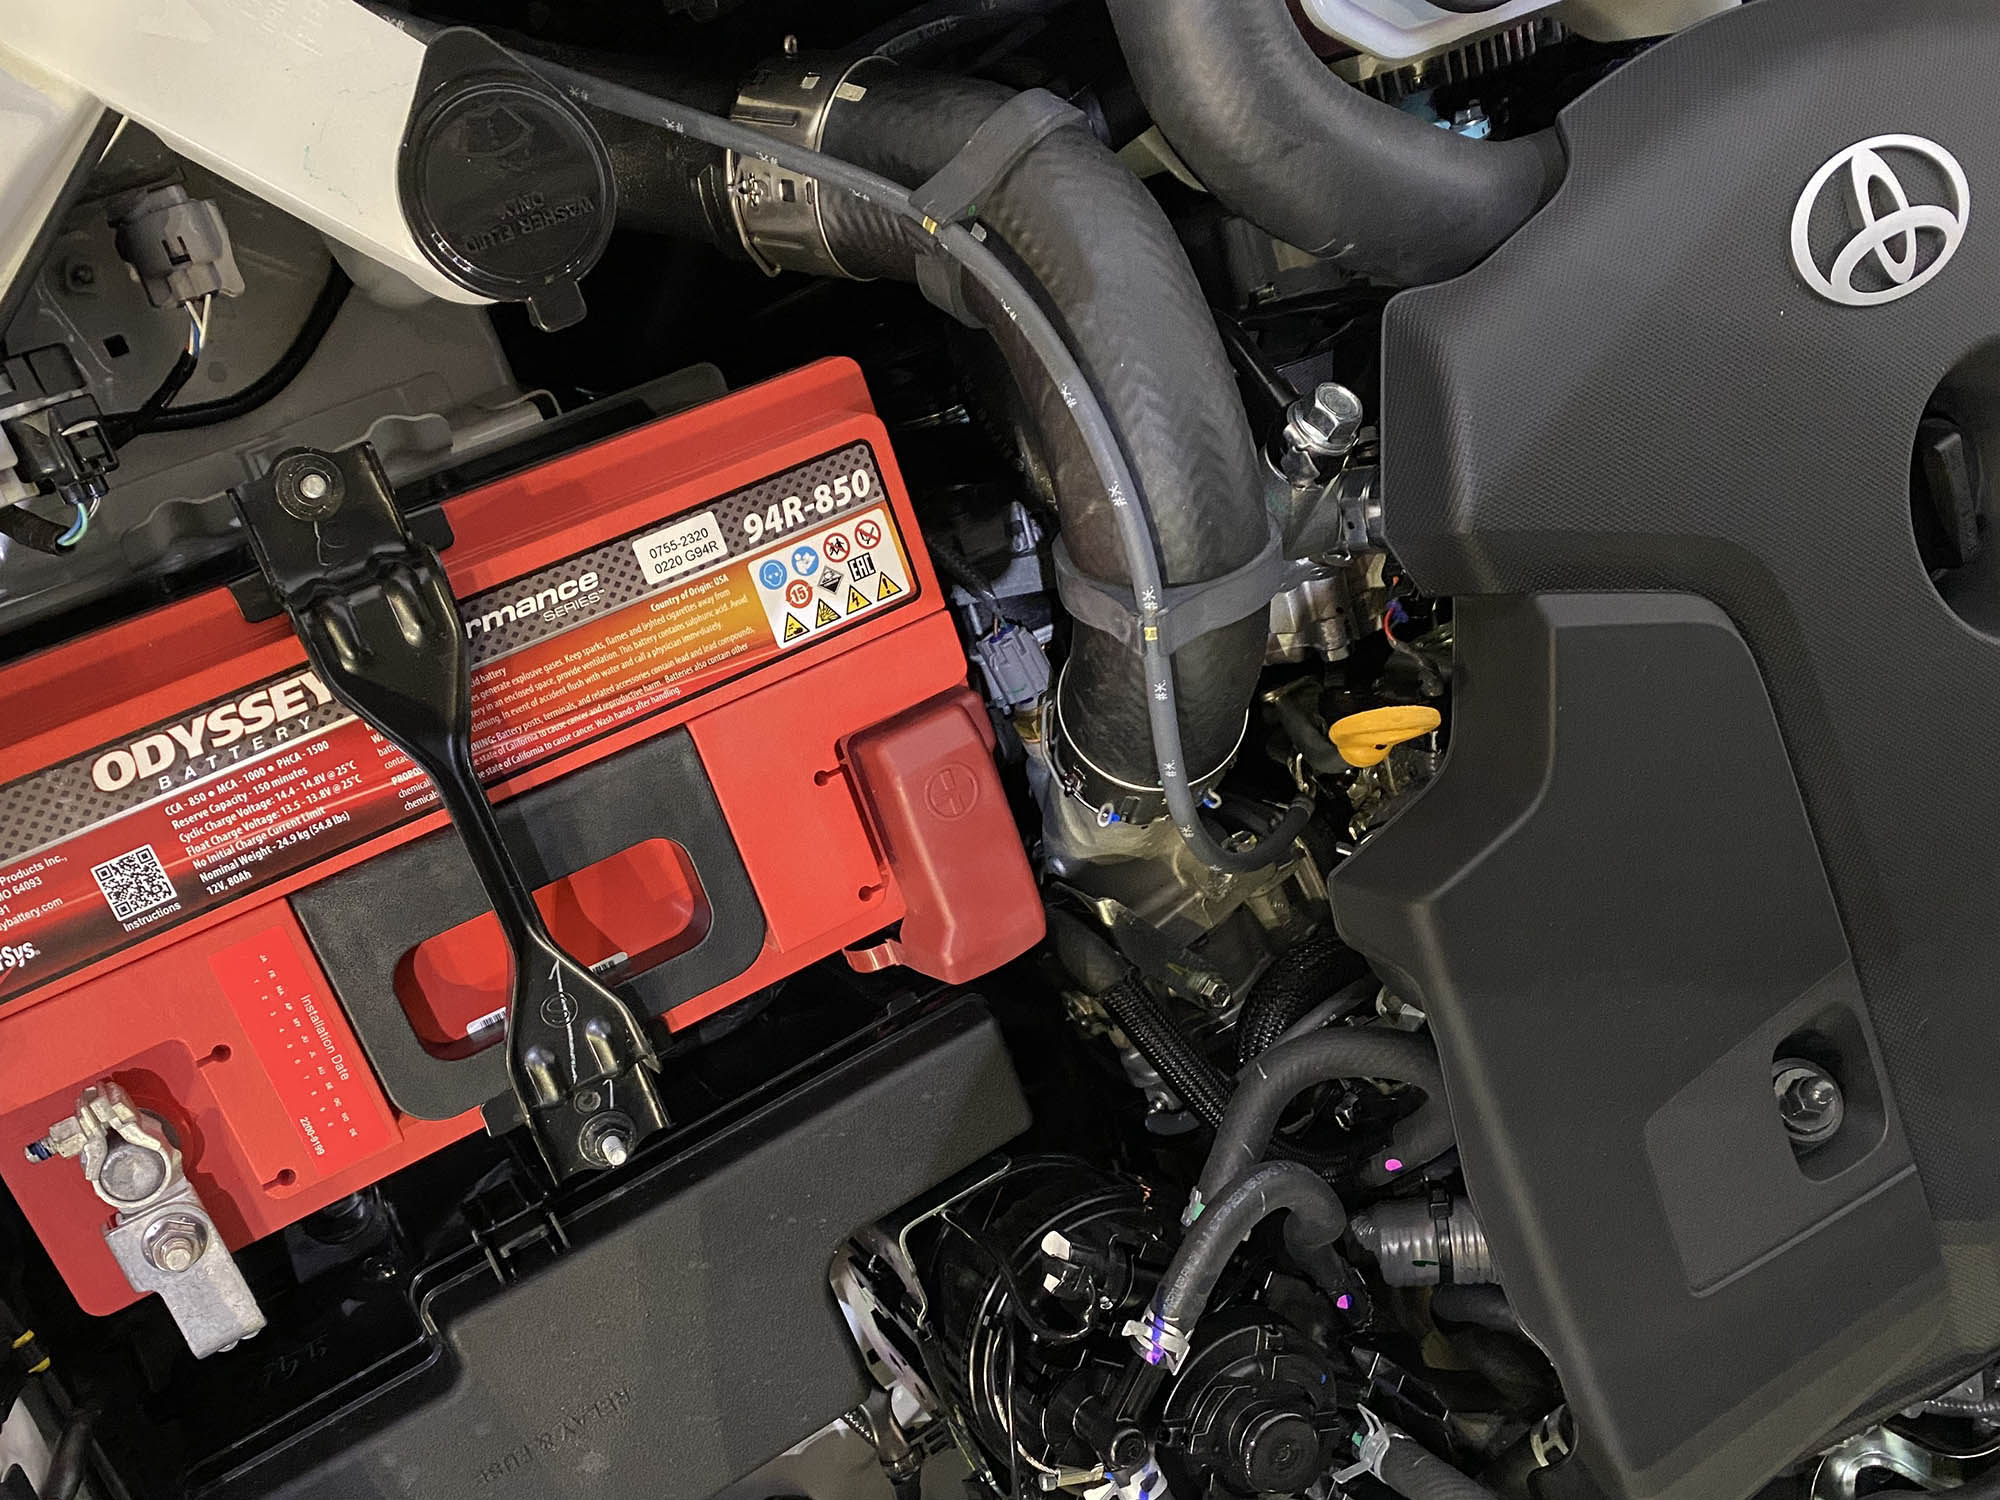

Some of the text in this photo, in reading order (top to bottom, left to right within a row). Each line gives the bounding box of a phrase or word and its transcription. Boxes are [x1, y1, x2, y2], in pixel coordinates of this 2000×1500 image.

[521, 197, 594, 236] WASHER
[743, 469, 872, 543] 94R-850
[648, 526, 709, 559] 0755-2320
[653, 539, 719, 575] 0220 G94R
[649, 573, 728, 614] Country of Origin: USA
[790, 585, 807, 601] 15
[479, 679, 512, 700] generate
[510, 665, 544, 687] explosive
[563, 649, 583, 664] Keep
[581, 640, 606, 657] sparks,
[604, 629, 628, 646] flames
[627, 624, 642, 636] and
[640, 613, 666, 632] lighted
[664, 601, 698, 622] cigarettes
[696, 595, 715, 609] away
[713, 587, 730, 600] from
[479, 665, 507, 685] battery
[485, 702, 494, 711] in
[493, 698, 504, 708] an
[502, 684, 534, 703] enclosed
[554, 664, 582, 683] provide
[618, 642, 633, 655] This
[631, 632, 658, 650] battery
[656, 620, 684, 638] contains
[501, 709, 510, 719] In
[509, 701, 530, 716] event
[529, 697, 539, 707] of
[537, 685, 567, 704] accident
[566, 677, 584, 691] flush
[583, 671, 600, 684] with
[599, 663, 620, 677] water
[619, 656, 634, 669] and
[632, 651, 646, 663] call
[650, 636, 682, 657] physician
[478, 749, 498, 763] state
[496, 745, 506, 755] of
[504, 731, 538, 751] California
[537, 728, 546, 737] to
[545, 720, 566, 734] cause
[566, 711, 588, 725] cancer
[587, 703, 602, 715] and
[600, 685, 644, 711] reproductive
[663, 663, 693, 683] Batteries
[692, 658, 706, 670] also
[706, 649, 731, 665] contain
[729, 641, 748, 655] other
[494, 723, 523, 743] Battery
[521, 714, 543, 731] posts,
[541, 699, 577, 722] terminals,
[575, 693, 591, 706] and
[590, 683, 615, 700] related
[613, 669, 650, 690] accessories
[649, 658, 675, 675] contain
[673, 651, 689, 664] lead
[688, 645, 703, 658] and
[701, 640, 717, 652] lead
[91, 670, 335, 793] ODYSSEY
[156, 715, 315, 790] BATTERY
[484, 761, 504, 775] state
[502, 758, 511, 767] of
[510, 743, 544, 764] California
[543, 740, 552, 750] to
[551, 732, 572, 746] cause
[594, 713, 614, 728] Wash
[612, 704, 635, 720] hands
[633, 696, 650, 710] after
[163, 739, 330, 817] CCA 850 MCA 1000 PHCA 1500
[171, 765, 308, 830] Reserve Capacity 150 minutes
[177, 824, 206, 844] Cyclic
[203, 810, 238, 834] Charge
[235, 794, 276, 820] Voltage:
[274, 786, 296, 802] 14.4
[299, 773, 326, 791] 14.8V
[325, 768, 337, 781] @
[185, 838, 211, 857] Float
[209, 824, 244, 848] Charge
[241, 808, 282, 833] Voltage:
[279, 800, 301, 816] 13.5
[304, 787, 332, 805] 13.8V
[330, 782, 342, 795] @
[192, 805, 326, 870] No Initial Charge Current Limit
[199, 810, 351, 883] Nominal Weight 24.9 kg (54.8 lbs)
[0, 850, 67, 886] Products Inc.,
[11, 875, 42, 895] 64093
[205, 868, 252, 896] 12V, 80Ah
[0, 897, 64, 932] ybattery.com
[123, 901, 182, 932] Instructions
[300, 994, 350, 1081] Installation Date
[300, 1117, 325, 1156] 2200-9199
